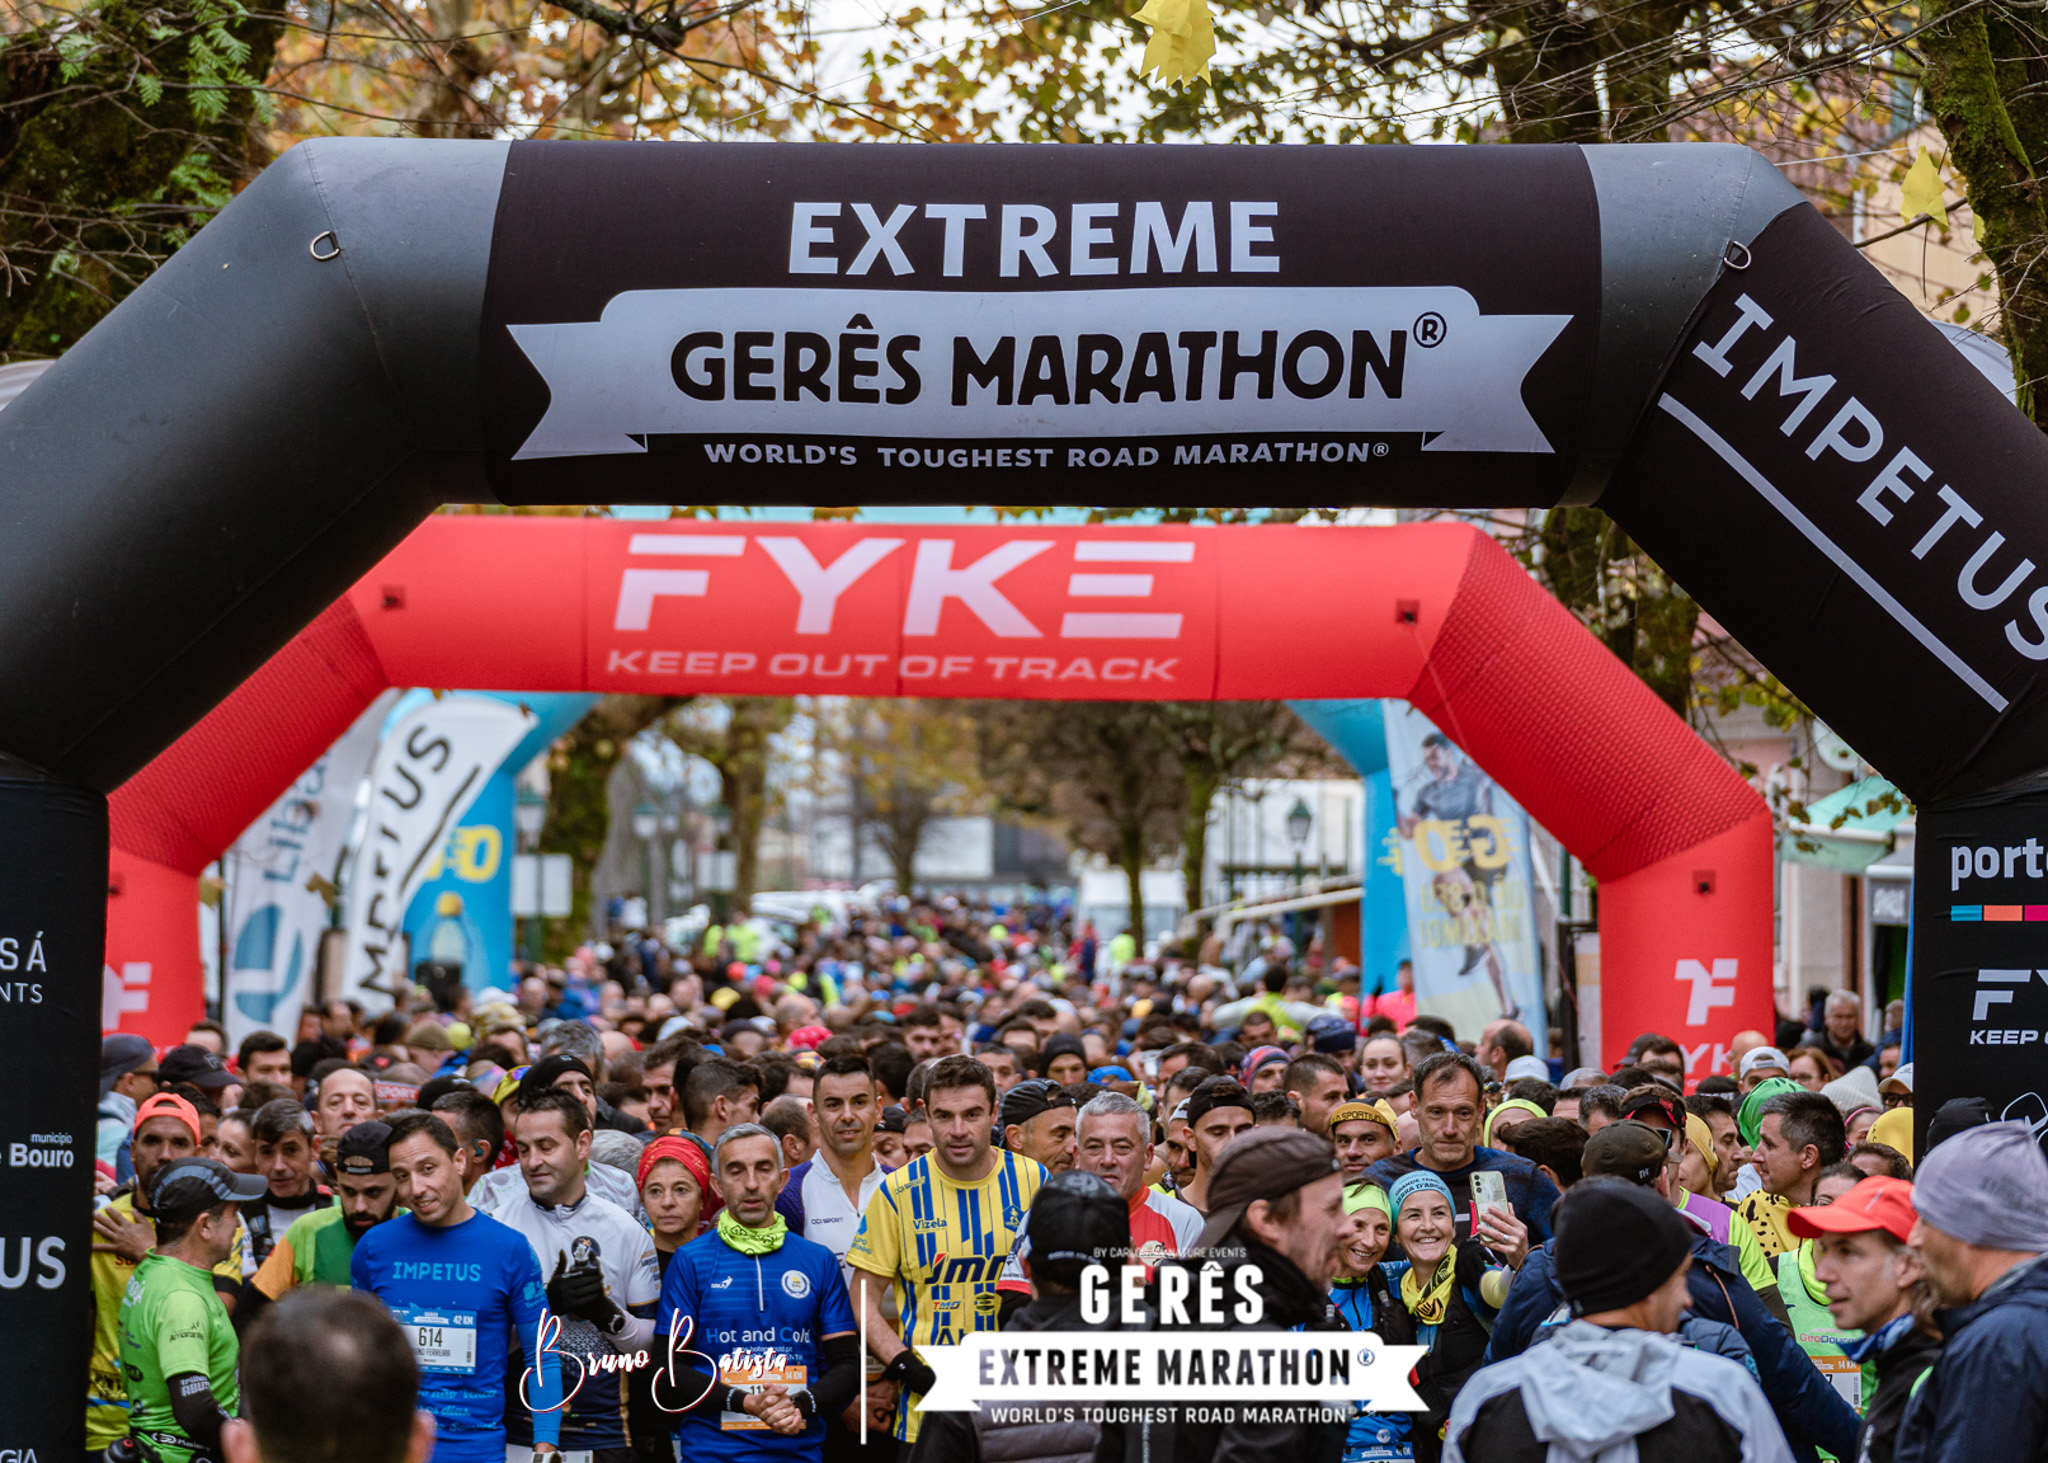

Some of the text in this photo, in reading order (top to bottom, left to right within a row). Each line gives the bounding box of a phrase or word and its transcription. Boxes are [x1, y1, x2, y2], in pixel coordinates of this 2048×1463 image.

[787, 201, 1281, 278] EXTREME
[670, 313, 921, 404] GERÊS
[704, 443, 857, 466] WORLD'S
[877, 447, 1053, 468] TOUGHEST
[1067, 447, 1159, 467] ROAD
[1692, 293, 2048, 662] IMPETUS
[614, 533, 1195, 639] FYKE
[607, 650, 1179, 681] KEEP OUT OF TRACK
[1951, 837, 2048, 891] port
[1970, 1030, 2039, 1045] KEEP
[9, 1142, 75, 1169] Bouro
[913, 1217, 947, 1230] Vizela
[0, 1235, 66, 1290] US
[392, 1261, 481, 1282] IMPETUS
[418, 1326, 443, 1348] 614
[705, 1327, 738, 1344] Hot
[742, 1326, 776, 1343] and
